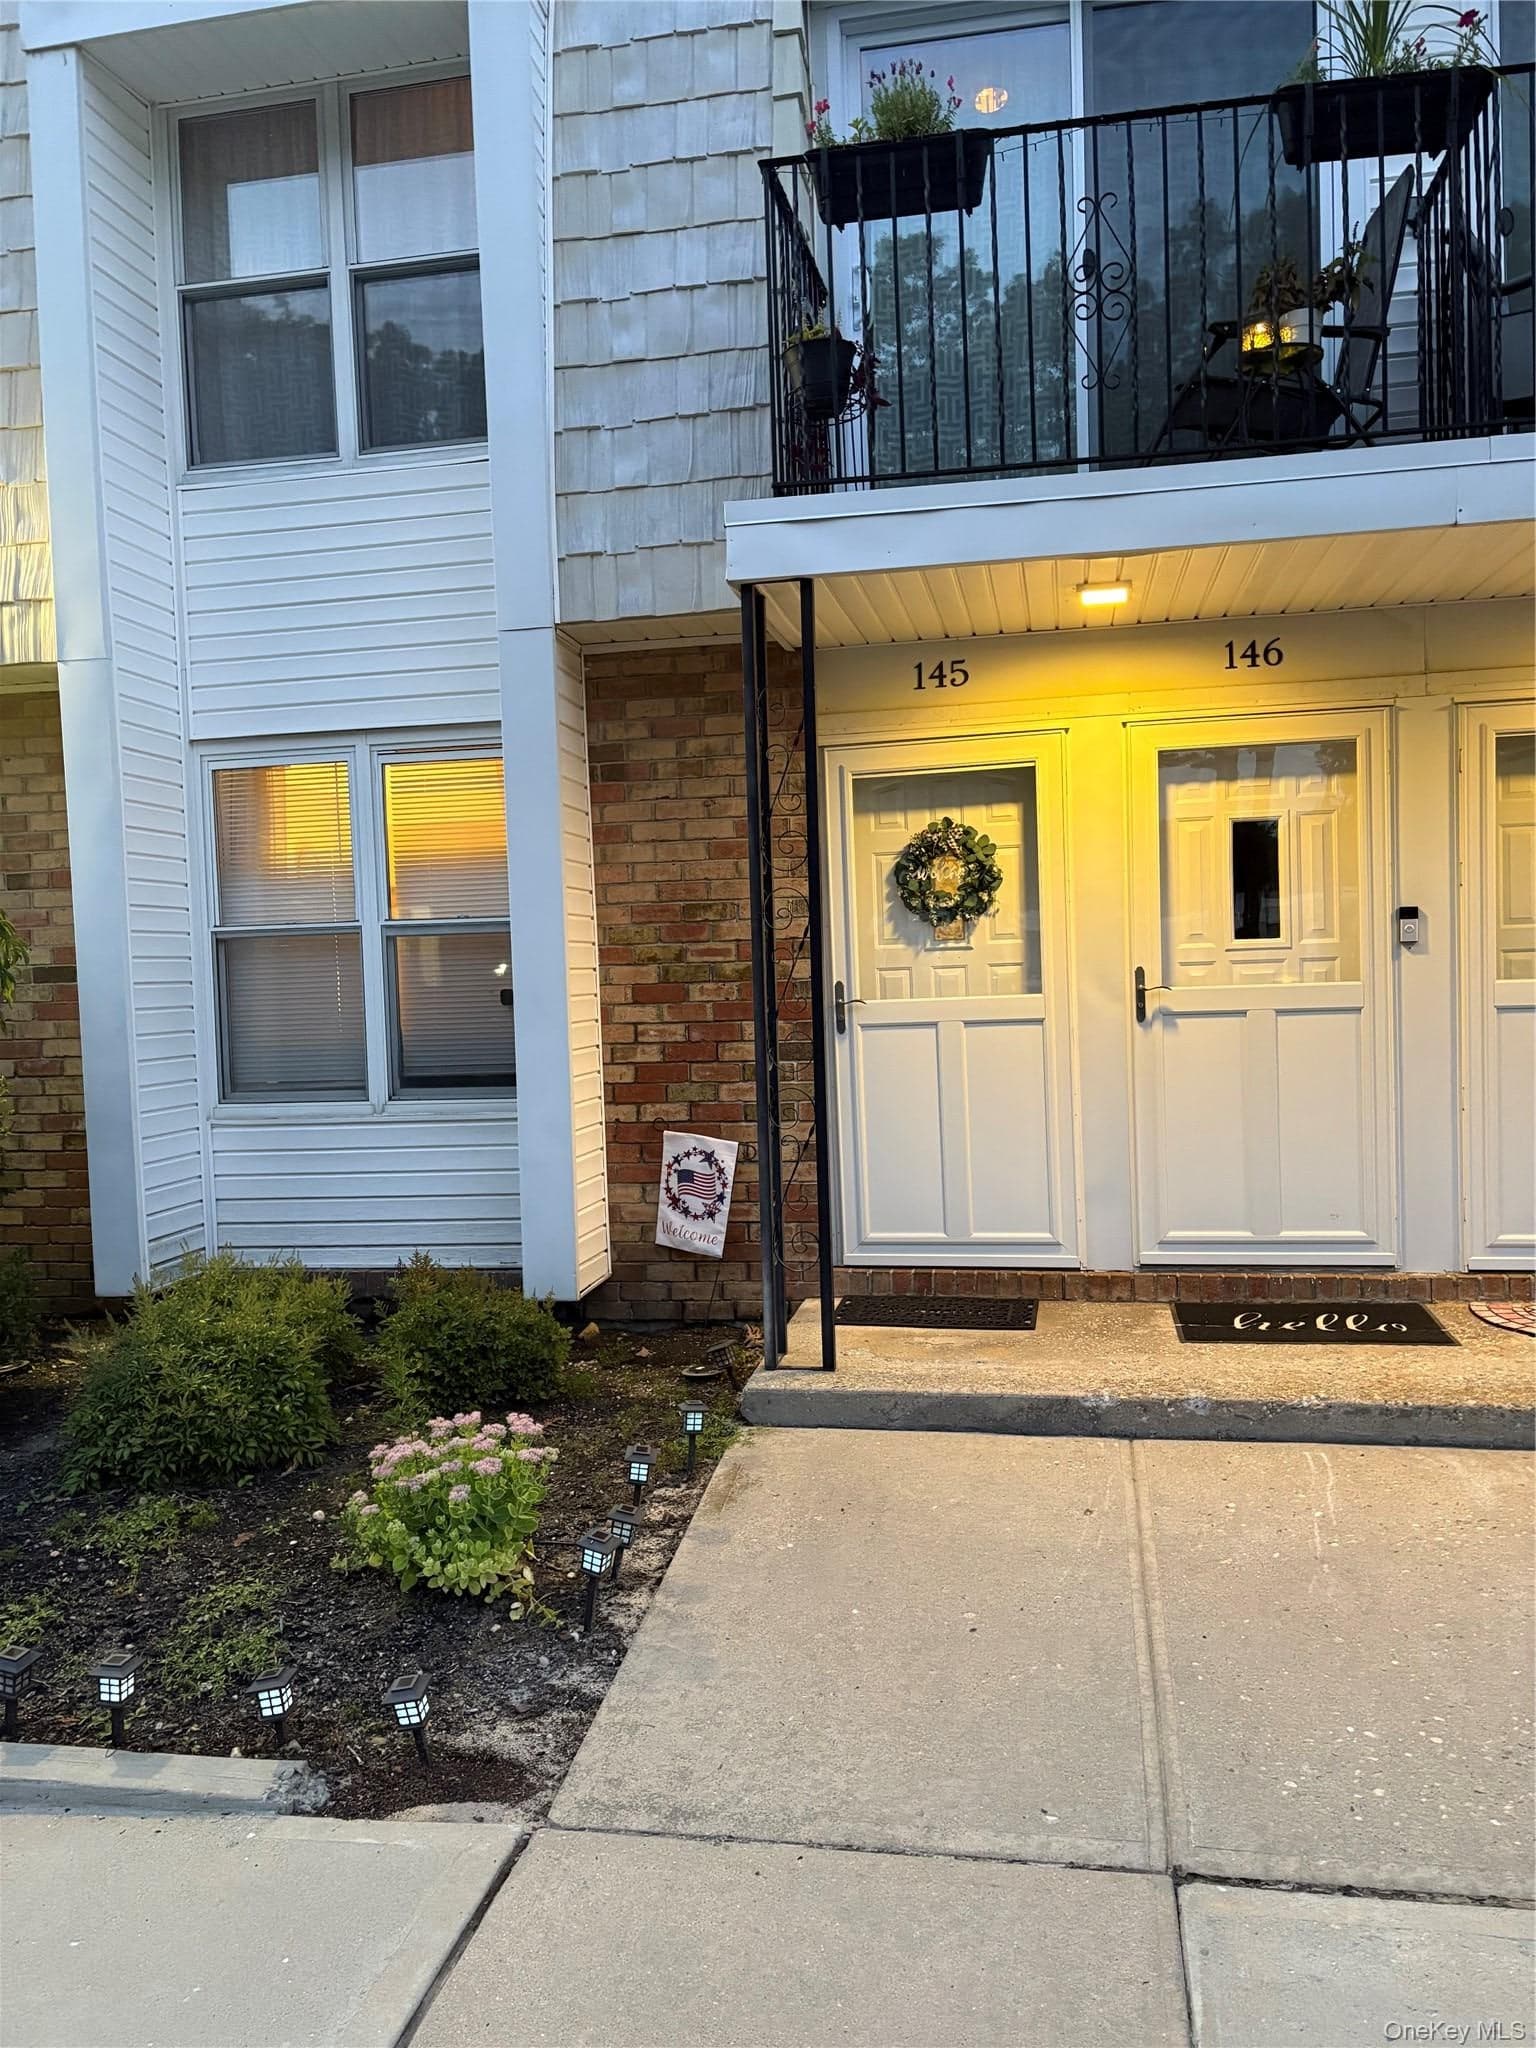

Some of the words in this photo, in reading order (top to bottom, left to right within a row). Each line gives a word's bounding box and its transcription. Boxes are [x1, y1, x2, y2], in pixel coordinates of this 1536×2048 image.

[1224, 637, 1284, 670] 146
[913, 659, 970, 690] 145
[661, 1220, 719, 1246] Welcome
[1232, 1311, 1408, 1332] hello
